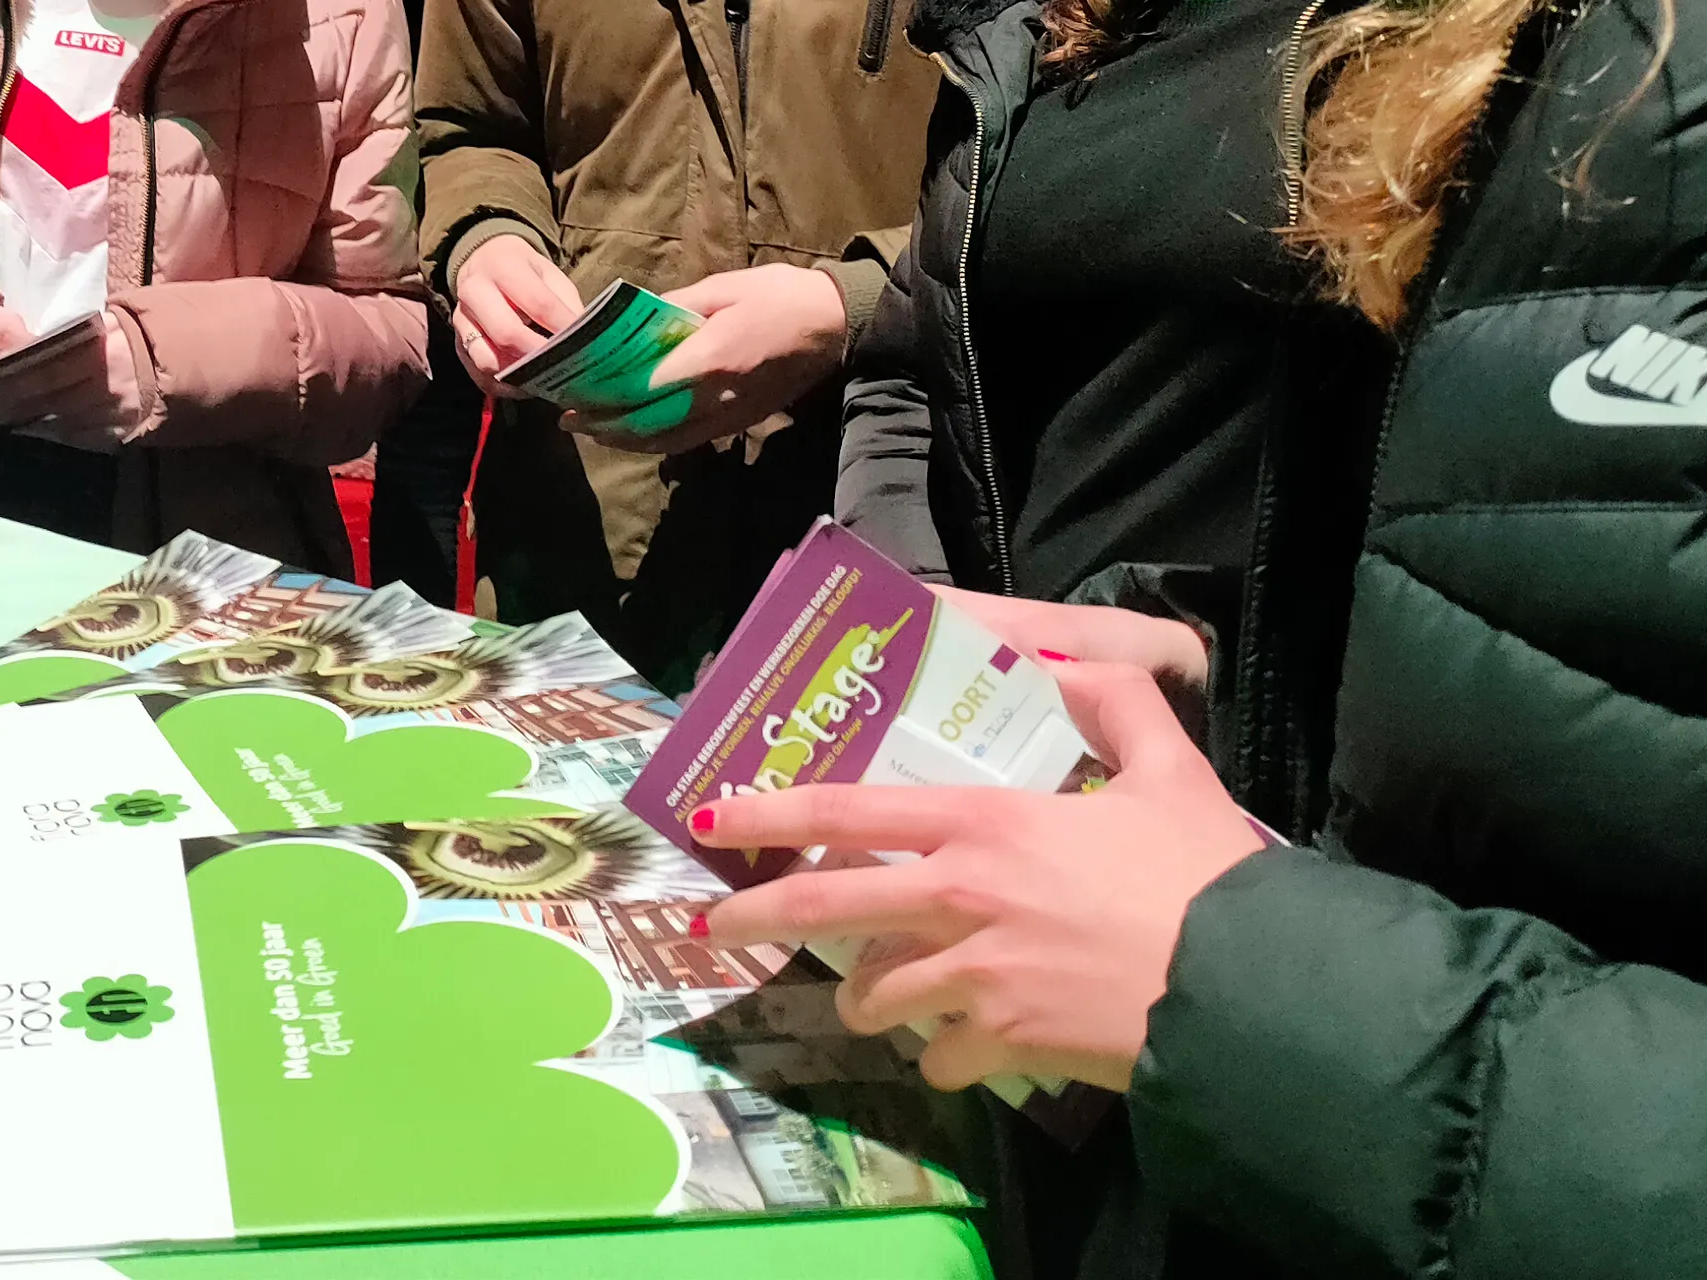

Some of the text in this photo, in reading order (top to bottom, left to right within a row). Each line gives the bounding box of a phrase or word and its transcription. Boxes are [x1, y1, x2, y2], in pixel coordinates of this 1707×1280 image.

[60, 31, 121, 53] LEVI'S
[1589, 323, 1707, 405] NIK
[664, 785, 683, 809] ON
[675, 756, 704, 794] STAGE
[696, 685, 756, 765] BEROEPENFEEST
[747, 673, 765, 693] EN
[808, 582, 833, 609] DOE
[823, 562, 848, 589] DAG
[762, 642, 885, 764] Stage
[938, 670, 997, 742] OORT
[234, 748, 269, 770] jaar
[264, 781, 292, 801] dan
[693, 766, 716, 795] MAG
[20, 980, 52, 1047] nova
[258, 921, 313, 1079] Meer dan 50 jaar
[296, 937, 354, 1055] Goed in Groen
